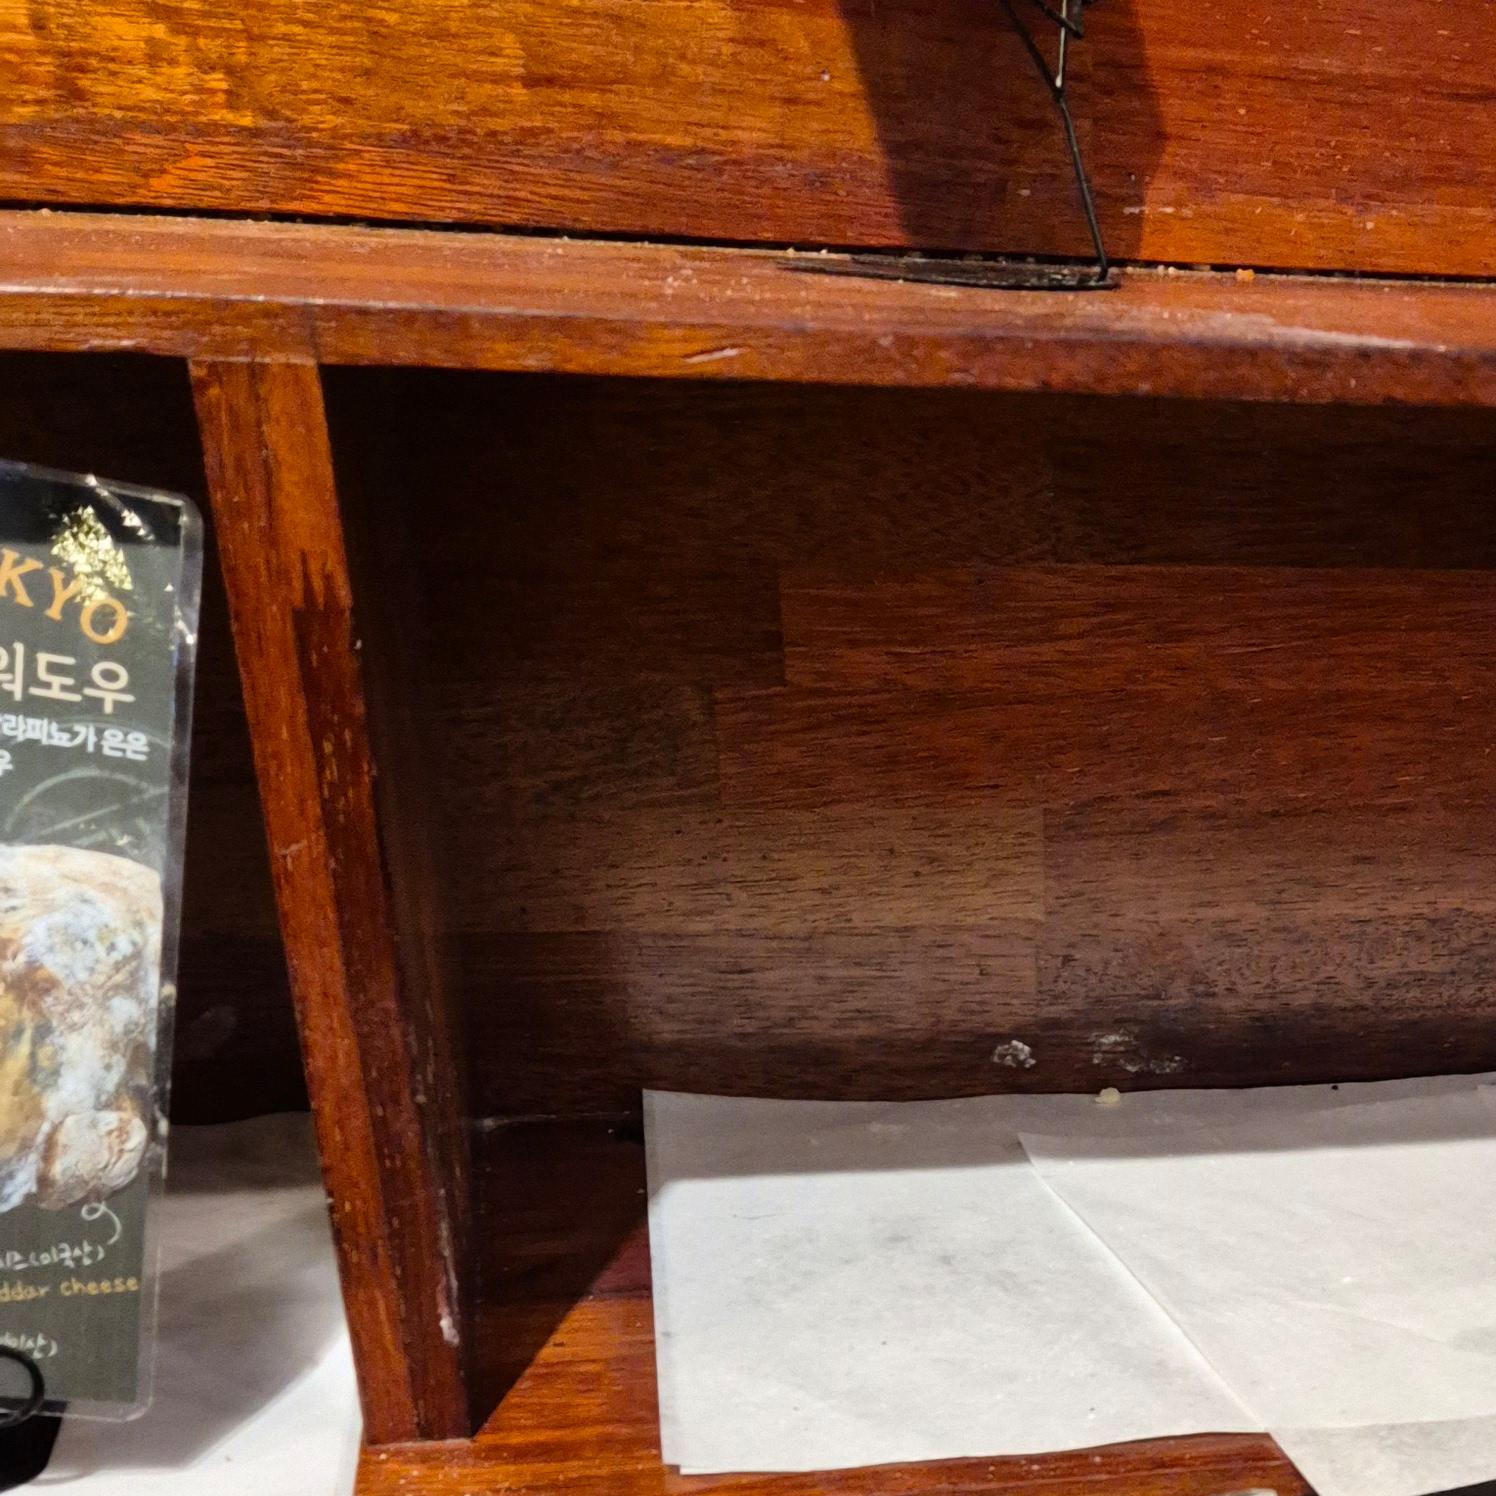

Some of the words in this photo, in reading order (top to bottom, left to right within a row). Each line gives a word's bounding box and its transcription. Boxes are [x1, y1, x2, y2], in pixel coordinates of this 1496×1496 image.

[0, 549, 129, 644] KYO
[0, 714, 97, 753] 라피뇨가
[101, 729, 150, 762] 은은
[60, 1277, 139, 1296] cheese
